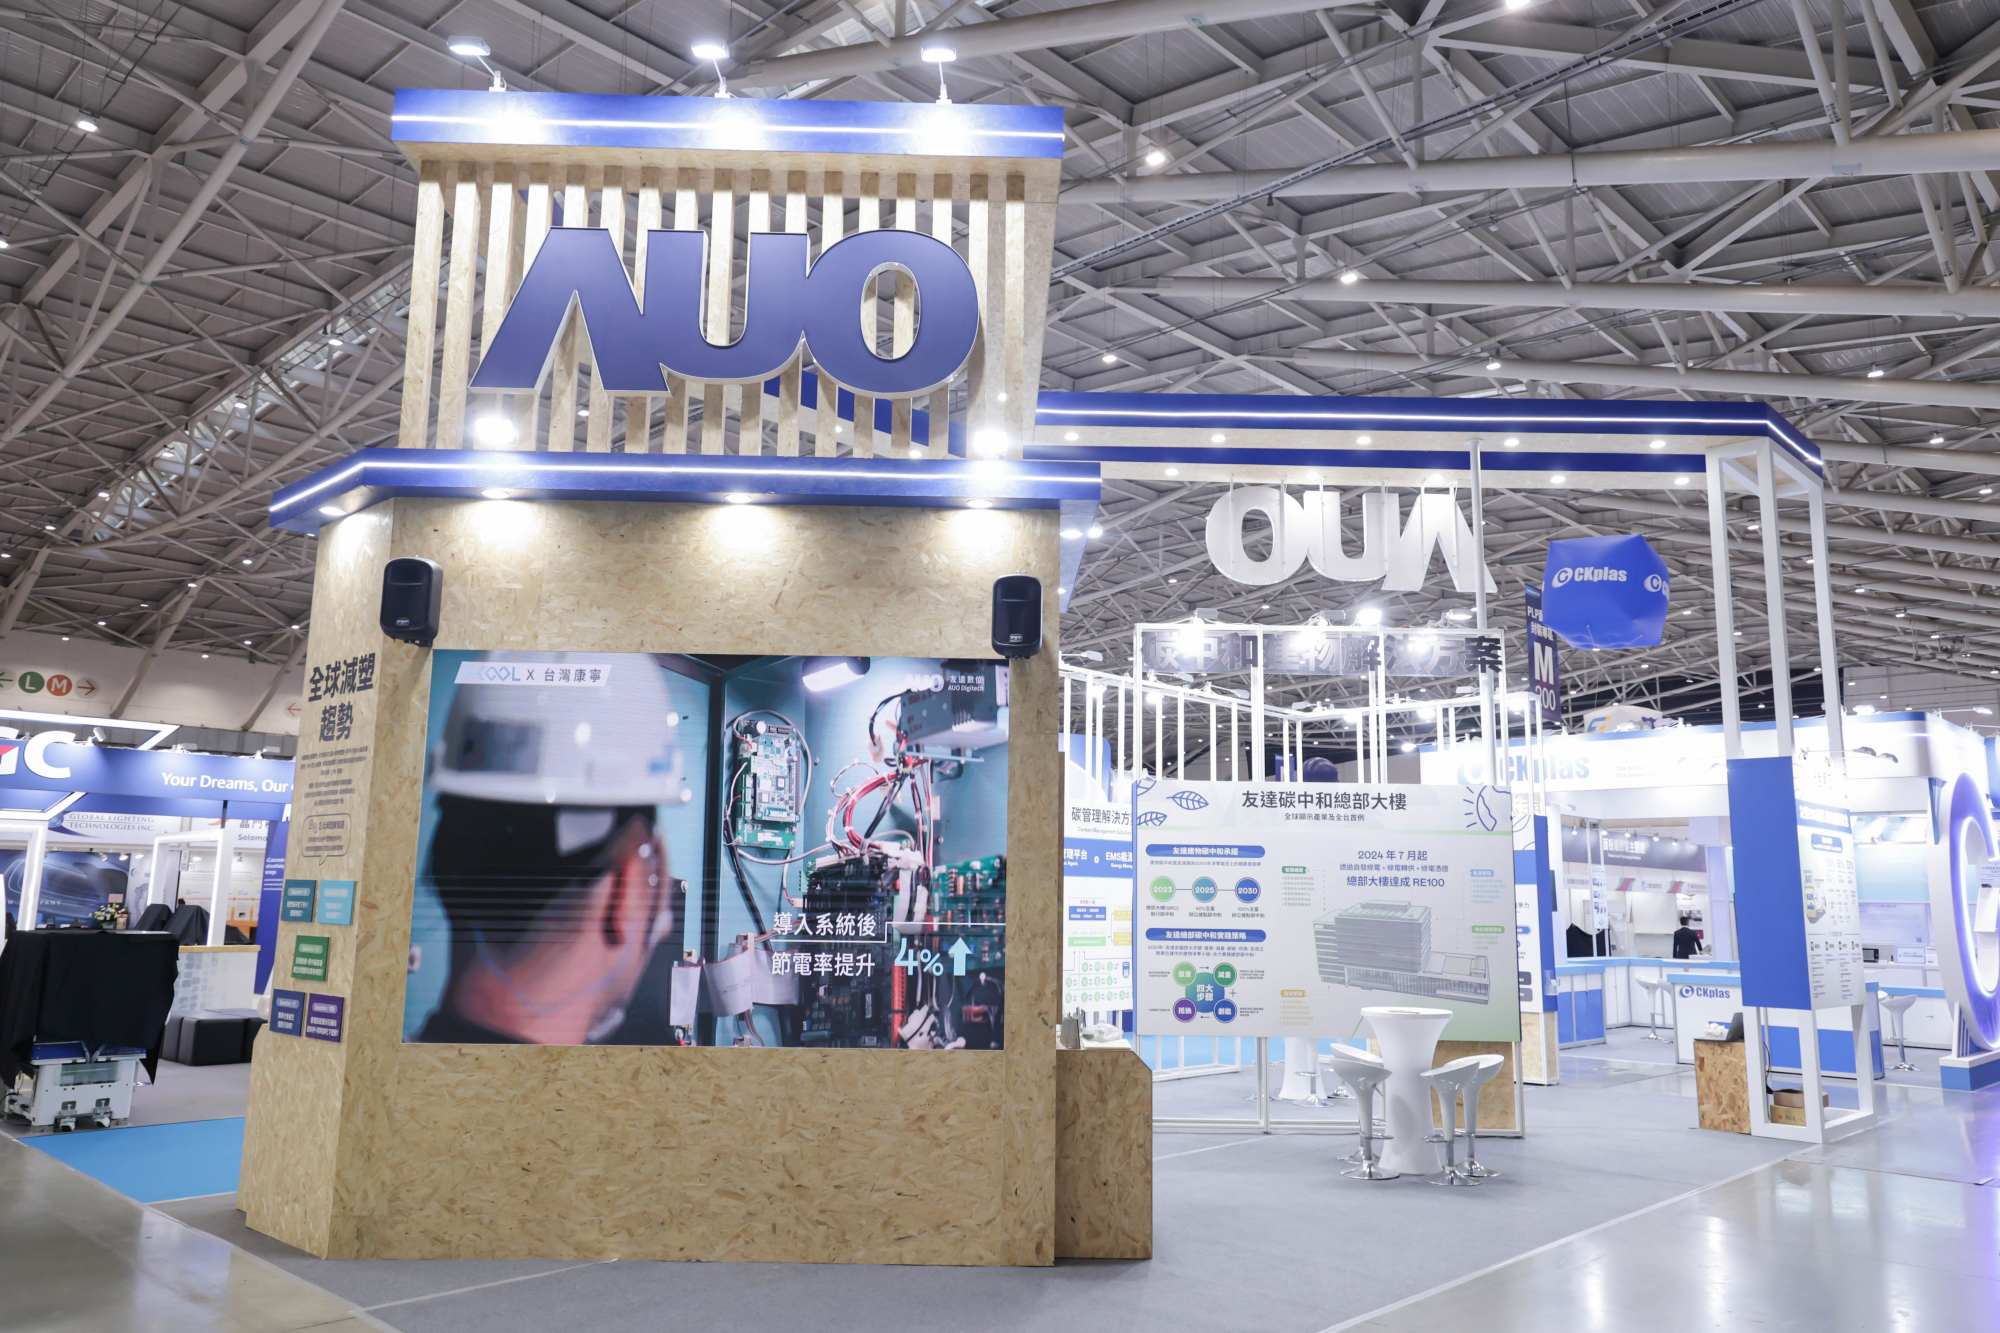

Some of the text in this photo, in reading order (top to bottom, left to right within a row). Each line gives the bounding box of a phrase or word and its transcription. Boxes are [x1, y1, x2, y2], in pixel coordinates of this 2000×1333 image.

[468, 226, 979, 398] AUO
[1574, 567, 1627, 582] CKplas
[1533, 642, 1554, 685] M
[308, 653, 376, 702] 全球減塑
[544, 668, 602, 683] 台灣康寧
[950, 675, 982, 684] 友達數位
[25, 676, 68, 693] L M
[319, 701, 353, 742] 趨勢
[161, 772, 289, 792] Your Dreams, Our
[1242, 790, 1407, 811] 友達碳中和總部大樓
[69, 813, 154, 824] GLOBAL LIGHTING
[1071, 807, 1133, 826] 碳管理解決方
[1284, 813, 1364, 822] 全球顯示產業及全台首例
[69, 823, 136, 832] TECHNOLOGIES
[1173, 847, 1238, 856] 友達建物碳中和承諾
[1358, 850, 1428, 861] 2024 年 7 月起
[1346, 876, 1445, 887] 總部大樓達成 RE100
[773, 912, 876, 937] 導入系統後
[771, 952, 875, 977] 節電率提升
[894, 938, 944, 977] 4%
[1196, 984, 1213, 993] 四大
[1696, 987, 1730, 998] CKplas
